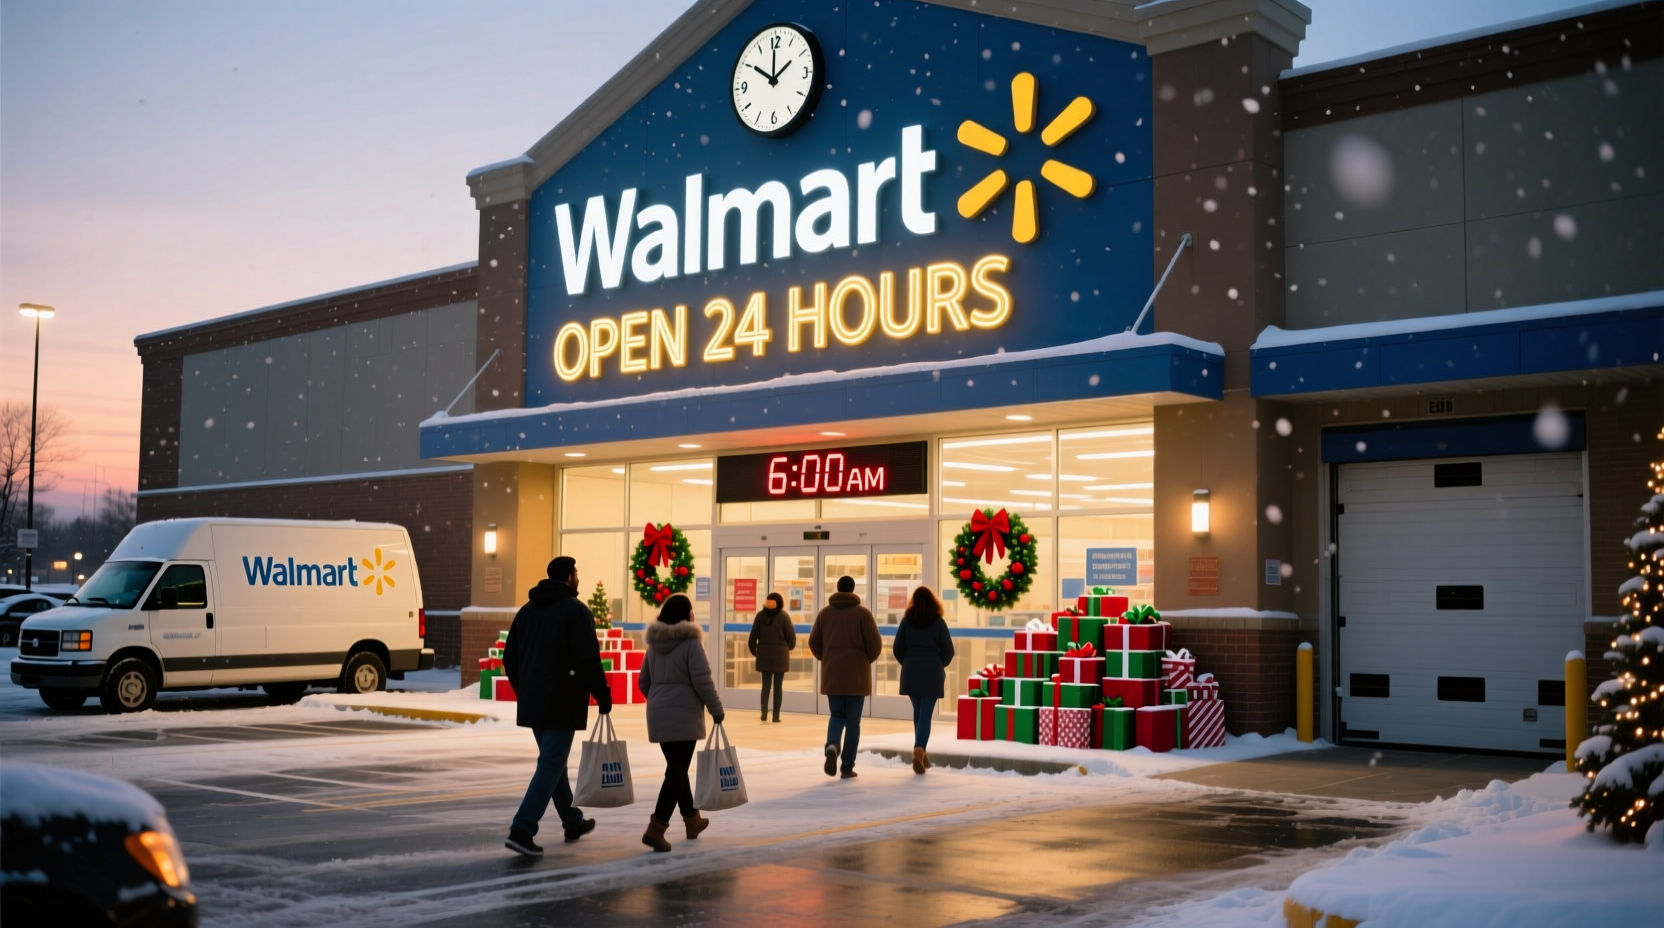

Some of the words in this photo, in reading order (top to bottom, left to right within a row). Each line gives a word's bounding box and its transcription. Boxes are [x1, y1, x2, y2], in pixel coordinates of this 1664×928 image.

[770, 35, 782, 49] 12
[741, 81, 748, 94] 9
[770, 110, 778, 125] 6
[554, 125, 936, 296] Walmart
[553, 305, 688, 382] OPEN
[703, 291, 772, 364] 24
[787, 254, 1012, 353] HOURS
[241, 556, 359, 587] Walmart
